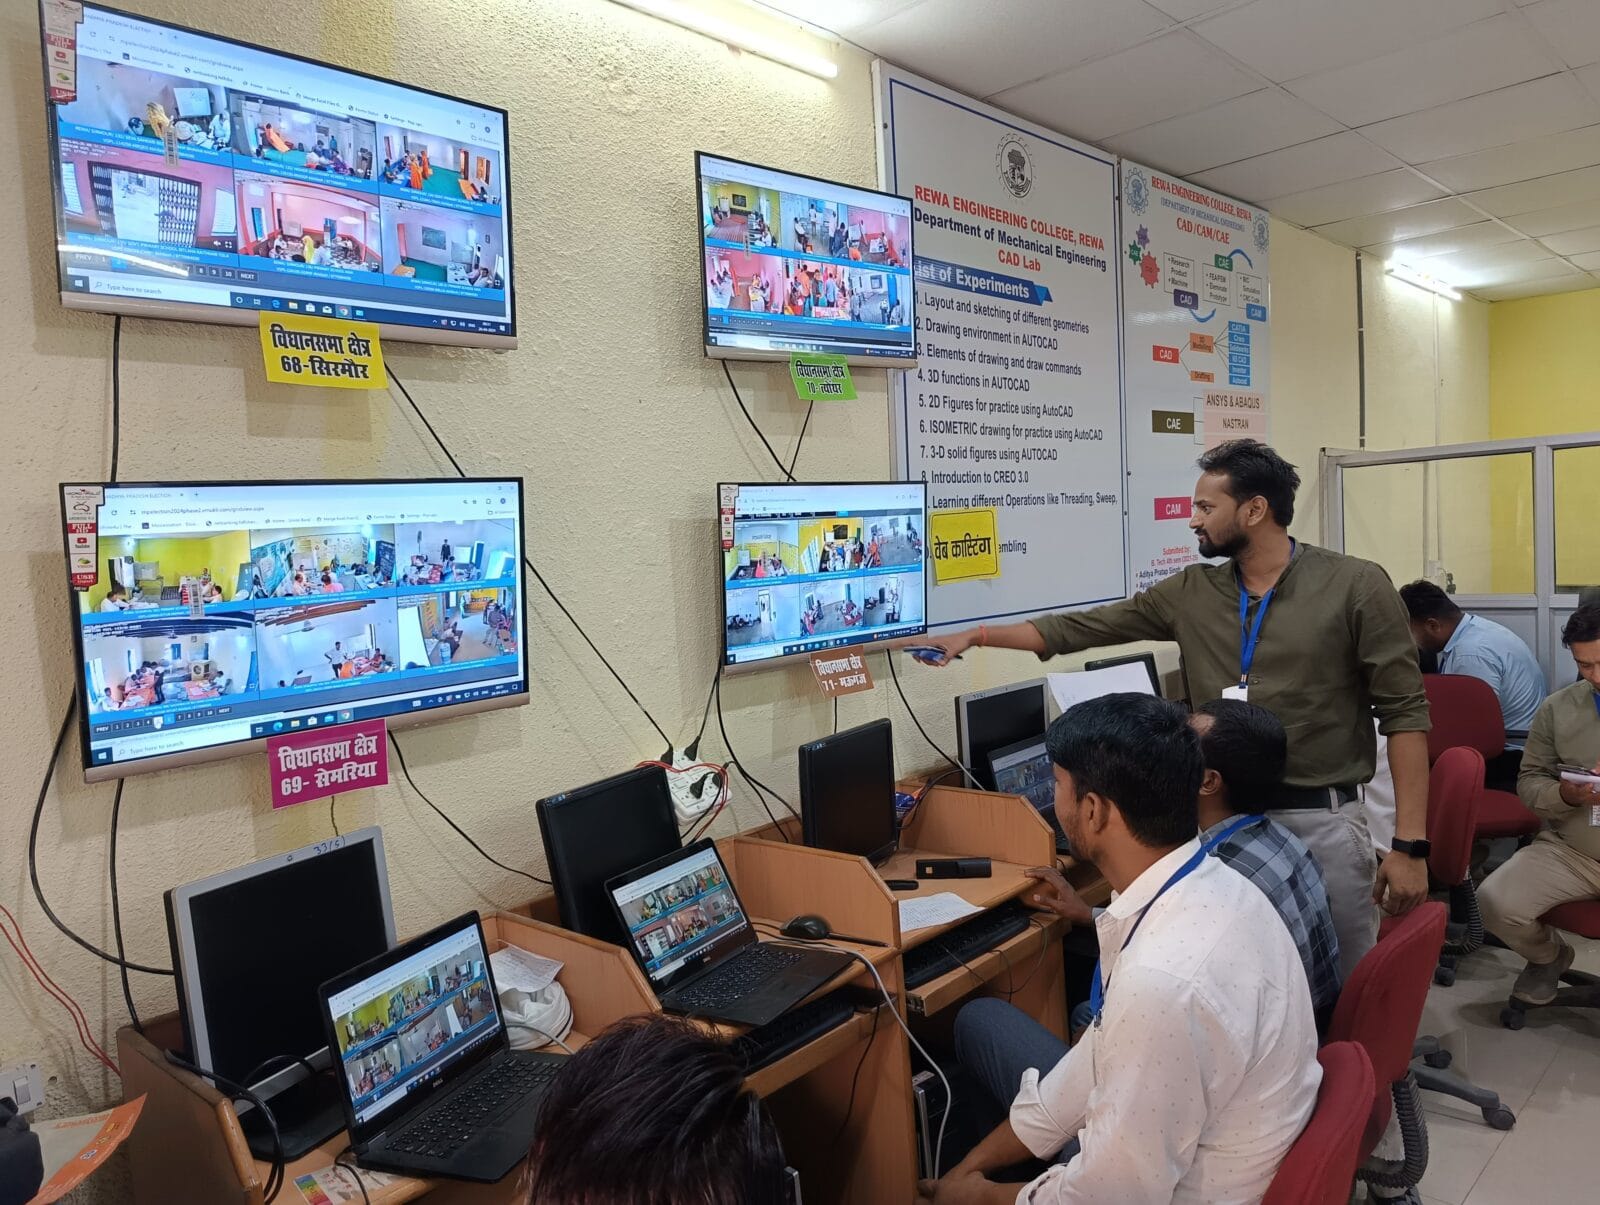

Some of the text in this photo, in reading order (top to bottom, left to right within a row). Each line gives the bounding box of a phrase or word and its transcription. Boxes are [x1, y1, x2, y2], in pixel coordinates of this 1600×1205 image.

[1152, 176, 1170, 193] REWA
[1172, 184, 1210, 206] ENGINEERING
[1236, 208, 1252, 221] REWA
[915, 185, 1104, 250] REWA ENGINEERING COLLEGE, REWA
[914, 207, 1106, 272] Department of Mechanical Engineering
[998, 250, 1041, 272] CAD Lab
[939, 266, 952, 282] of
[956, 268, 1030, 299] Experiments
[1180, 294, 1192, 305] CAD
[925, 292, 954, 312] Layout
[956, 299, 972, 314] and
[974, 302, 1010, 323] sketching
[1012, 308, 1021, 322] of
[1022, 310, 1052, 327] different
[1053, 318, 1090, 334] geometries
[270, 324, 372, 357] विधानसभा क्षेत्र
[926, 318, 960, 338] Drawing
[963, 326, 1012, 344] environment
[1014, 333, 1020, 345] in
[1022, 334, 1058, 350] AUTOCAD
[916, 342, 1082, 376] 3. Elements of drawing and draw commands
[1159, 350, 1172, 359] CAD
[796, 360, 845, 378] विधानसभा क्षेत्र
[918, 370, 1030, 392] 4. 3D functions in AUTOCAD
[919, 394, 1073, 418] 5. 2D Figures for practice using AutoCAD
[1207, 394, 1260, 409] ANSYS & ABAQUS
[920, 420, 1103, 442] 6. ISOMETRIC drawing for practice using AutoCAD
[1166, 418, 1181, 430] CAE
[1223, 419, 1248, 430] NASTRAN
[920, 445, 1058, 463] 7. 3-D solid figures using AUTOCAD
[932, 470, 981, 484] Introduction
[983, 471, 991, 483] to
[993, 471, 1016, 484] CREO
[1018, 470, 1029, 483] 3.0
[933, 495, 970, 508] Learning
[972, 495, 1004, 508] different
[1006, 494, 1045, 507] Operations
[1047, 493, 1059, 505] like
[1060, 492, 1094, 506] Threading,
[1165, 503, 1181, 515] CAM
[934, 536, 948, 560] वेब
[951, 533, 991, 556] कास्टिंग
[998, 540, 1027, 554] embling
[278, 733, 377, 772] विधानसभा क्षेत्र
[314, 761, 377, 788] सेमरिया
